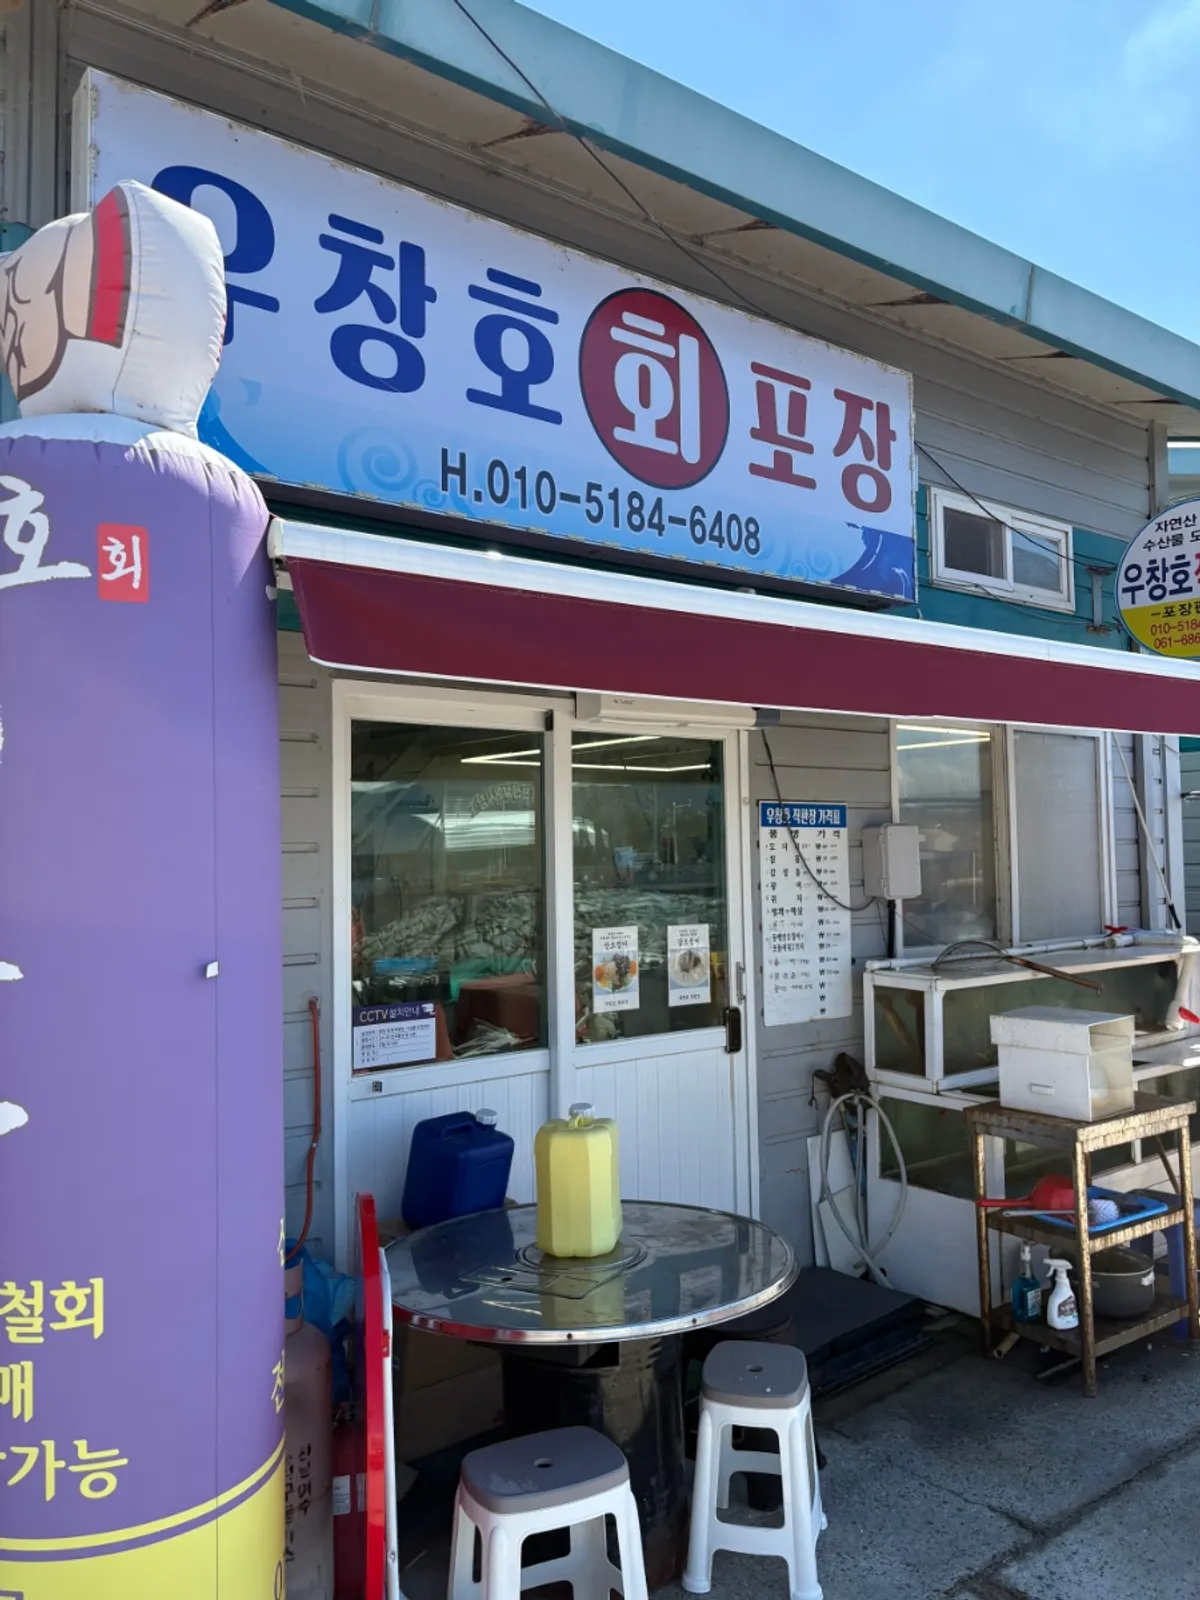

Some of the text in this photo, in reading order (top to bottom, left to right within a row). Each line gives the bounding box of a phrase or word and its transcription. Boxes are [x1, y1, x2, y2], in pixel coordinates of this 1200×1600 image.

[152, 164, 563, 425] 우창호
[748, 360, 897, 514] 포장
[440, 446, 761, 556] H.010-5184-6408
[1155, 514, 1198, 533] 자연산
[101, 535, 142, 589] 회
[1142, 533, 1184, 551] 수산물
[1121, 554, 1193, 605] 우창호
[360, 1009, 388, 1022] CCTV
[0, 1439, 128, 1502] 가능
